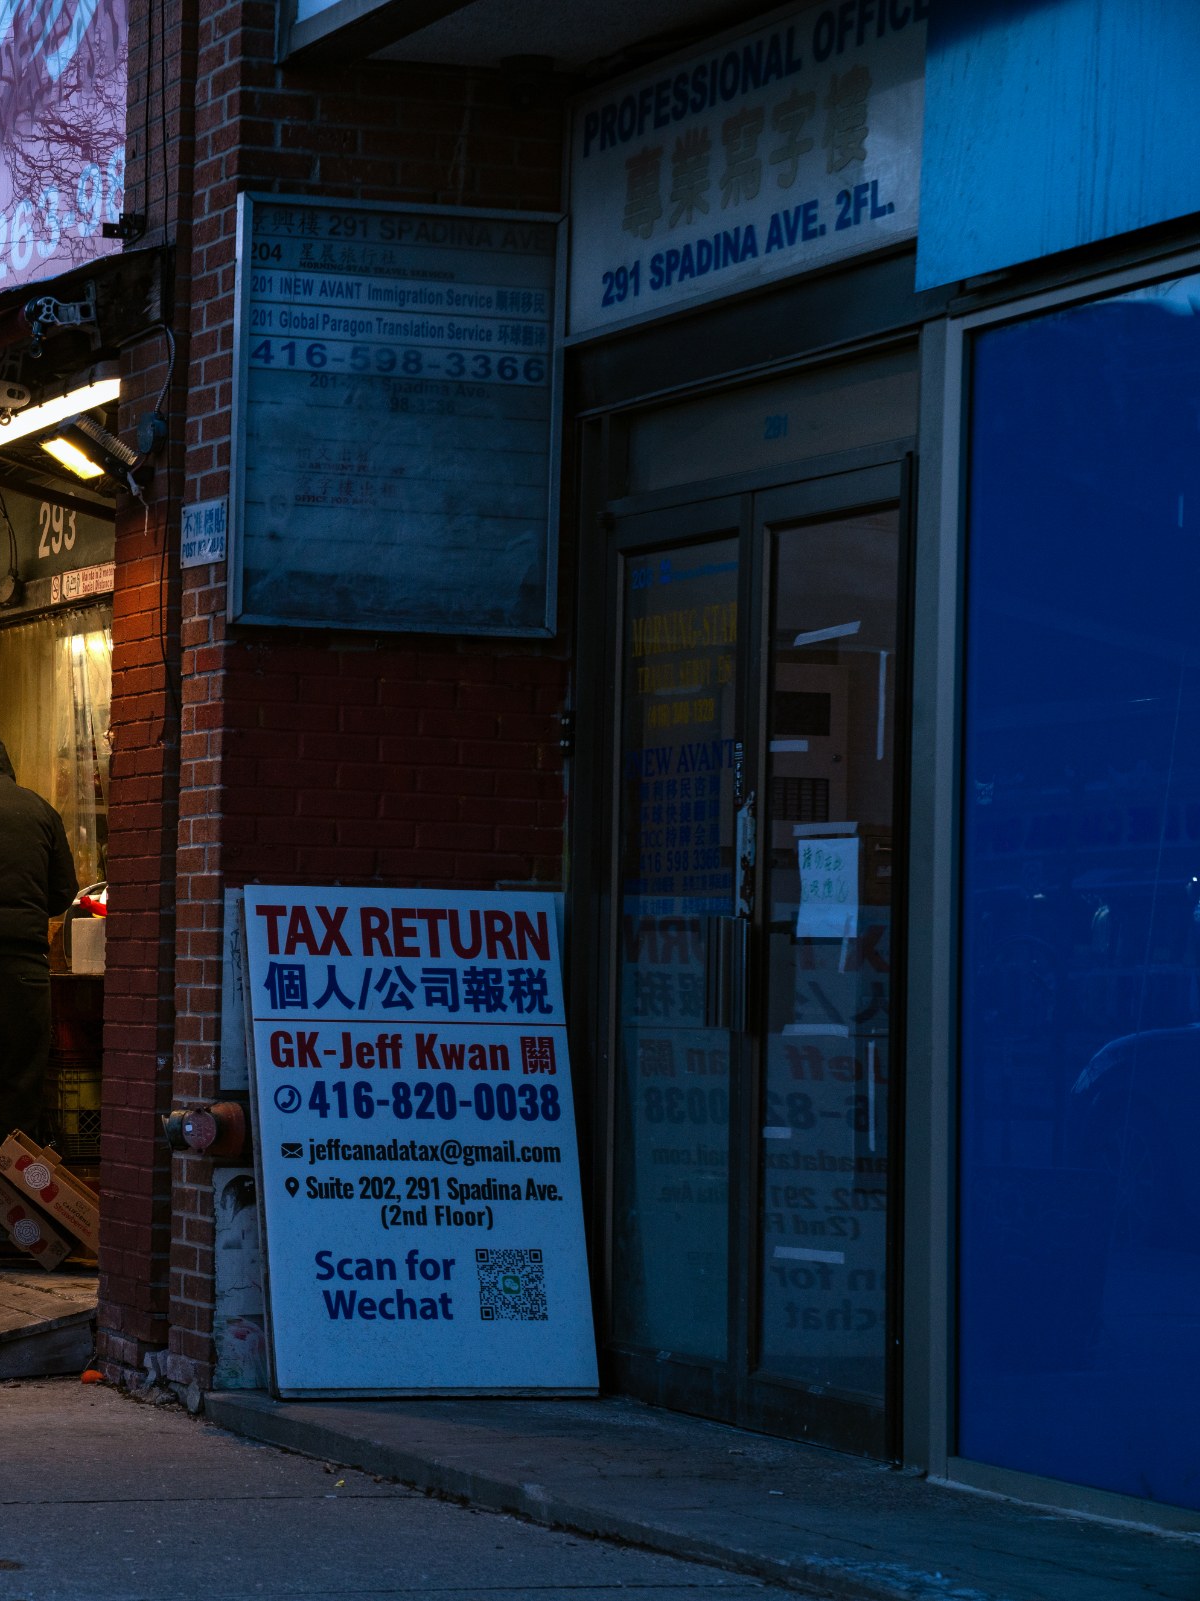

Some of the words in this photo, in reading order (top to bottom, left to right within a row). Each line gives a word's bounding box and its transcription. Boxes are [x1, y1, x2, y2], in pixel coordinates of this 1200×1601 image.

[584, 26, 802, 158] PROFESSIONAL
[328, 214, 369, 240] 291
[379, 217, 492, 248] SPADINA
[602, 261, 640, 307] 291
[650, 225, 758, 290] SPADINA
[765, 200, 826, 253] AVE.
[835, 180, 895, 232] 2FL.
[252, 275, 273, 293] 201
[319, 280, 362, 300] AVANT
[367, 286, 443, 308] Immigration
[446, 290, 492, 309] Service
[252, 309, 273, 327] 201
[279, 310, 319, 331] Global
[322, 313, 373, 337] Paragon
[375, 317, 444, 339] Translation
[447, 322, 492, 342] Service
[251, 339, 545, 382] 416-598-3366
[38, 501, 77, 559] 293
[256, 904, 352, 957] TAX
[360, 907, 551, 961] RETURN
[270, 1030, 402, 1070] GK-Jeff
[416, 1033, 511, 1071] Kwan
[520, 1036, 557, 1075] 關
[308, 1080, 562, 1122] 416-820-0038
[308, 1138, 561, 1166] jeffcanadatax@gmail.com
[306, 1176, 354, 1200] Suite
[359, 1177, 401, 1204] 202,
[405, 1177, 440, 1201] 291
[447, 1177, 522, 1203] Spadina
[525, 1179, 563, 1202] Ave.
[381, 1204, 428, 1231] (2nd
[434, 1205, 494, 1231] Floor)
[315, 1250, 397, 1282] Scan
[405, 1249, 456, 1281] for
[322, 1290, 454, 1321] Wechat
